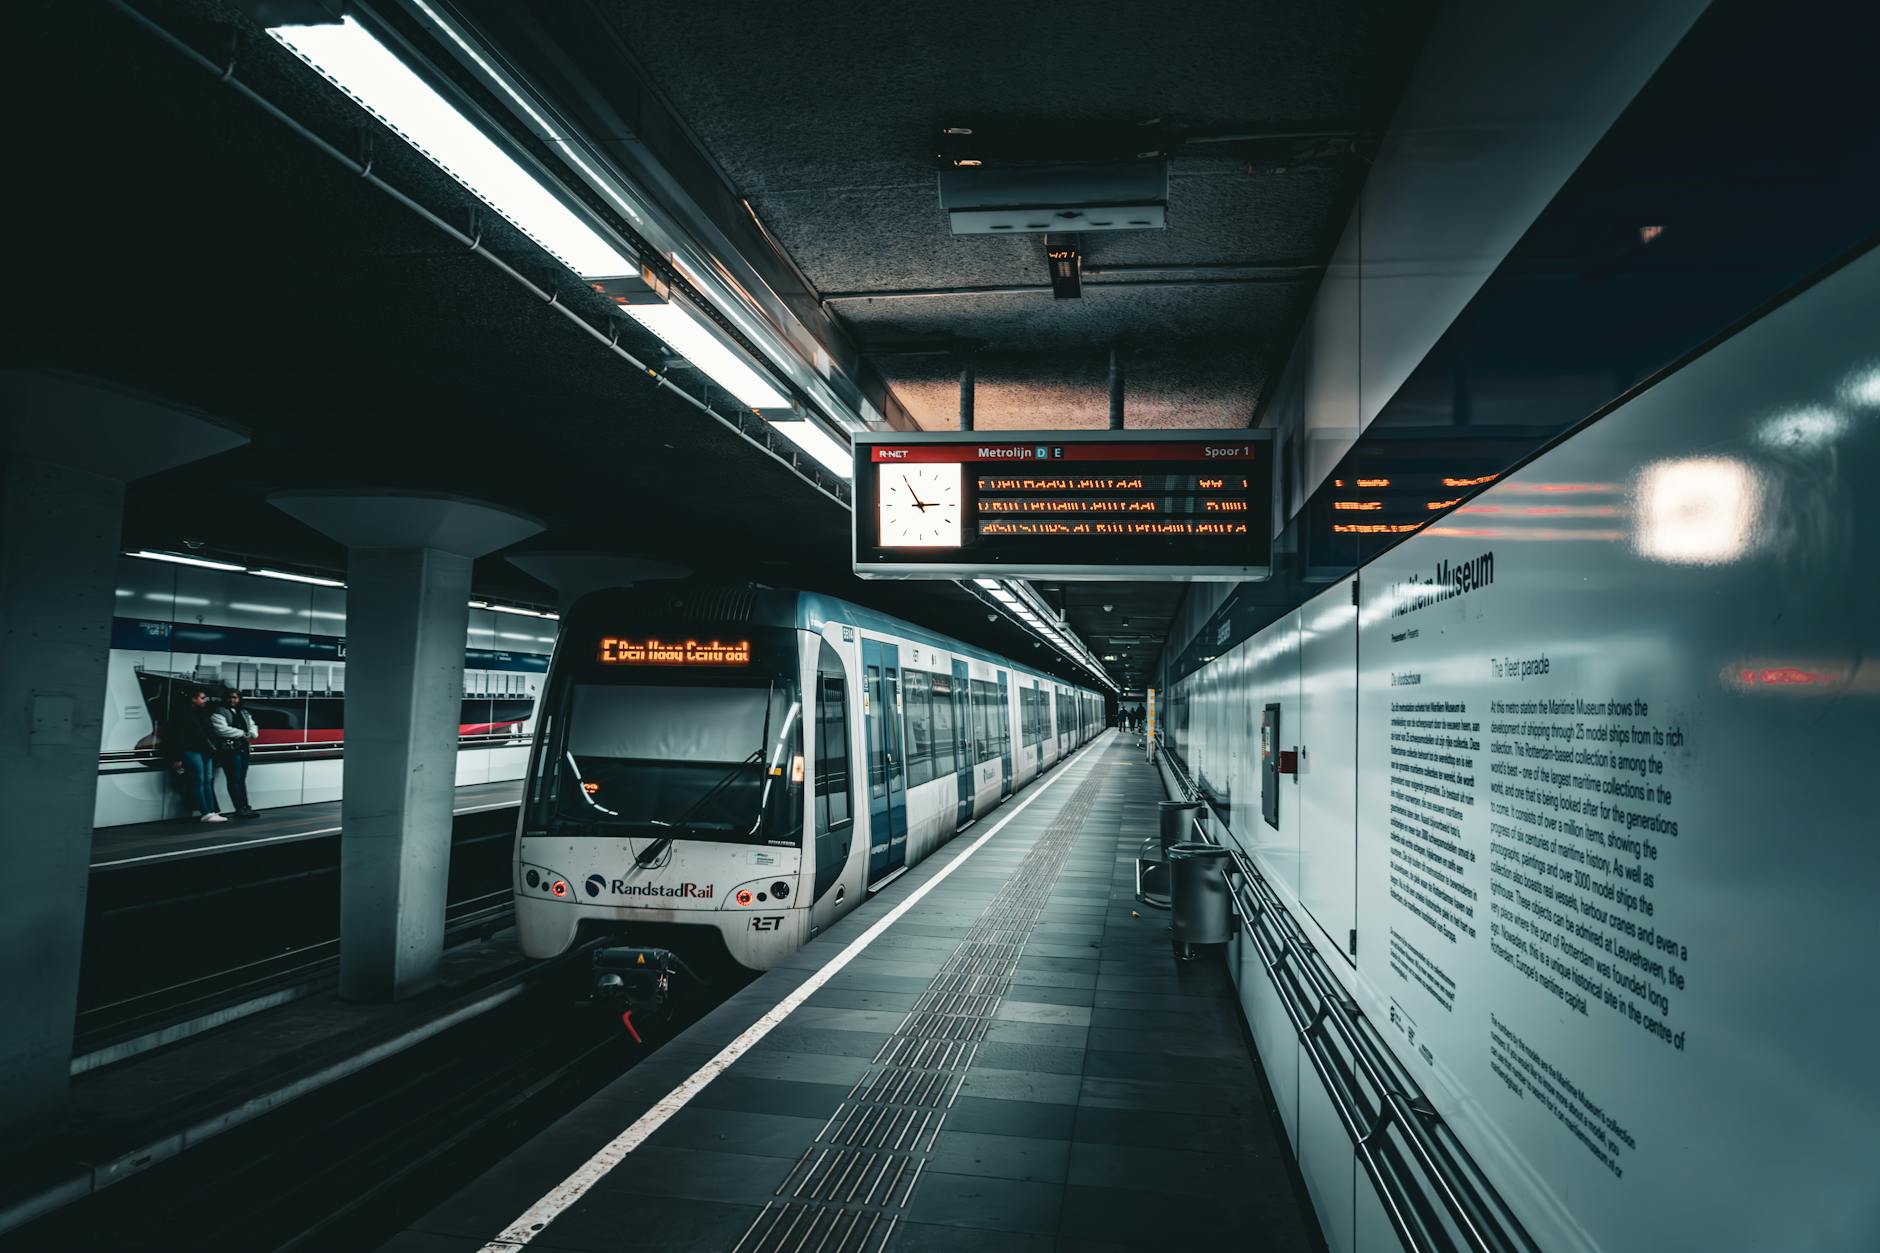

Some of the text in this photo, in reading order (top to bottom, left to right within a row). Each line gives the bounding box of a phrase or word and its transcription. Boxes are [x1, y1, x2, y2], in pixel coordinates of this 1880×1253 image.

[978, 448, 1062, 459] Metrolijn D E
[1205, 447, 1249, 457] Spoor 1
[1437, 551, 1493, 602] Museum
[1491, 659, 1503, 677] The
[1522, 654, 1549, 680] parade
[1505, 700, 1519, 714] metro
[1520, 700, 1537, 714] station
[1539, 699, 1547, 714] the
[1549, 699, 1575, 715] Maritime
[1577, 699, 1606, 715] Museum
[1607, 699, 1632, 716] shows
[1634, 698, 1647, 716] the
[1521, 723, 1526, 735] of
[1527, 723, 1550, 740] shipping
[1552, 723, 1575, 742] through
[1576, 724, 1584, 739] 25
[1586, 725, 1607, 741] model
[1609, 725, 1629, 747] ships
[1631, 726, 1651, 744] from
[1653, 726, 1663, 745] its
[1666, 727, 1683, 746] rich
[1514, 743, 1524, 757] This
[1576, 748, 1608, 767] collection
[1610, 750, 1615, 768] is
[1618, 755, 1646, 776] among
[1648, 753, 1662, 773] the
[1508, 764, 1517, 778] best
[1523, 769, 1533, 780] one
[1534, 768, 1539, 781] of
[1541, 768, 1549, 783] the
[1551, 769, 1571, 789] largest
[1573, 773, 1601, 792] maritime
[1603, 777, 1644, 799] collections
[1647, 781, 1654, 801] in
[1657, 783, 1671, 804] the
[1505, 785, 1514, 798] and
[1515, 789, 1524, 800] one
[1525, 787, 1535, 803] that
[1537, 789, 1541, 804] is
[1543, 790, 1558, 812] being
[1560, 793, 1581, 813] looked
[1583, 798, 1598, 817] after
[1600, 800, 1610, 820] for
[1613, 803, 1624, 823] the
[1626, 810, 1678, 836] generations
[1511, 805, 1514, 818] It
[1516, 809, 1536, 824] consists
[1537, 812, 1543, 826] of
[1544, 817, 1556, 830] over
[1558, 820, 1562, 832] a
[1564, 818, 1583, 838] million
[1608, 829, 1641, 861] showing
[1643, 836, 1657, 860] the
[1511, 827, 1516, 840] of
[1525, 833, 1549, 851] centuries
[1550, 839, 1556, 854] of
[1558, 843, 1584, 863] maritime
[1613, 857, 1623, 877] As
[1625, 863, 1641, 883] well
[1643, 871, 1654, 887] as
[612, 879, 713, 899] RandstadRail
[1522, 853, 1545, 876] paintings
[1547, 862, 1558, 878] and
[1559, 867, 1573, 884] over
[1574, 869, 1590, 891] 3000
[1592, 878, 1614, 900] model
[1616, 885, 1637, 912] ships
[1639, 891, 1653, 915] the
[752, 917, 784, 930] RET
[1513, 871, 1523, 886] also
[1524, 874, 1542, 895] boasts
[1543, 885, 1553, 900] real
[1581, 897, 1608, 924] harbour
[1609, 913, 1636, 937] cranes
[1638, 925, 1654, 945] and
[1656, 933, 1678, 956] even
[1681, 943, 1687, 960] a
[1515, 889, 1530, 909] These
[1532, 898, 1552, 920] objects
[1553, 910, 1564, 927] can
[1566, 912, 1574, 932] be
[1576, 919, 1603, 947] admired
[1605, 932, 1612, 952] at
[1669, 959, 1684, 989] the
[1500, 908, 1513, 923] place
[1514, 915, 1529, 932] where
[1530, 922, 1538, 938] the
[1540, 930, 1552, 945] port
[1553, 935, 1559, 949] of
[1561, 937, 1594, 968] Rotterdam
[1596, 959, 1611, 978] was
[1613, 964, 1646, 997] founded
[1648, 982, 1668, 1014] long
[1529, 943, 1538, 960] this
[1540, 949, 1544, 964] is
[1546, 955, 1549, 967] a
[1551, 958, 1570, 980] unique
[1572, 967, 1602, 999] historical
[1604, 987, 1618, 1009] site
[1619, 994, 1626, 1014] in
[1628, 999, 1641, 1023] the
[1643, 1012, 1672, 1041] centre
[1674, 1028, 1685, 1050] of
[1540, 973, 1564, 999] maritime
